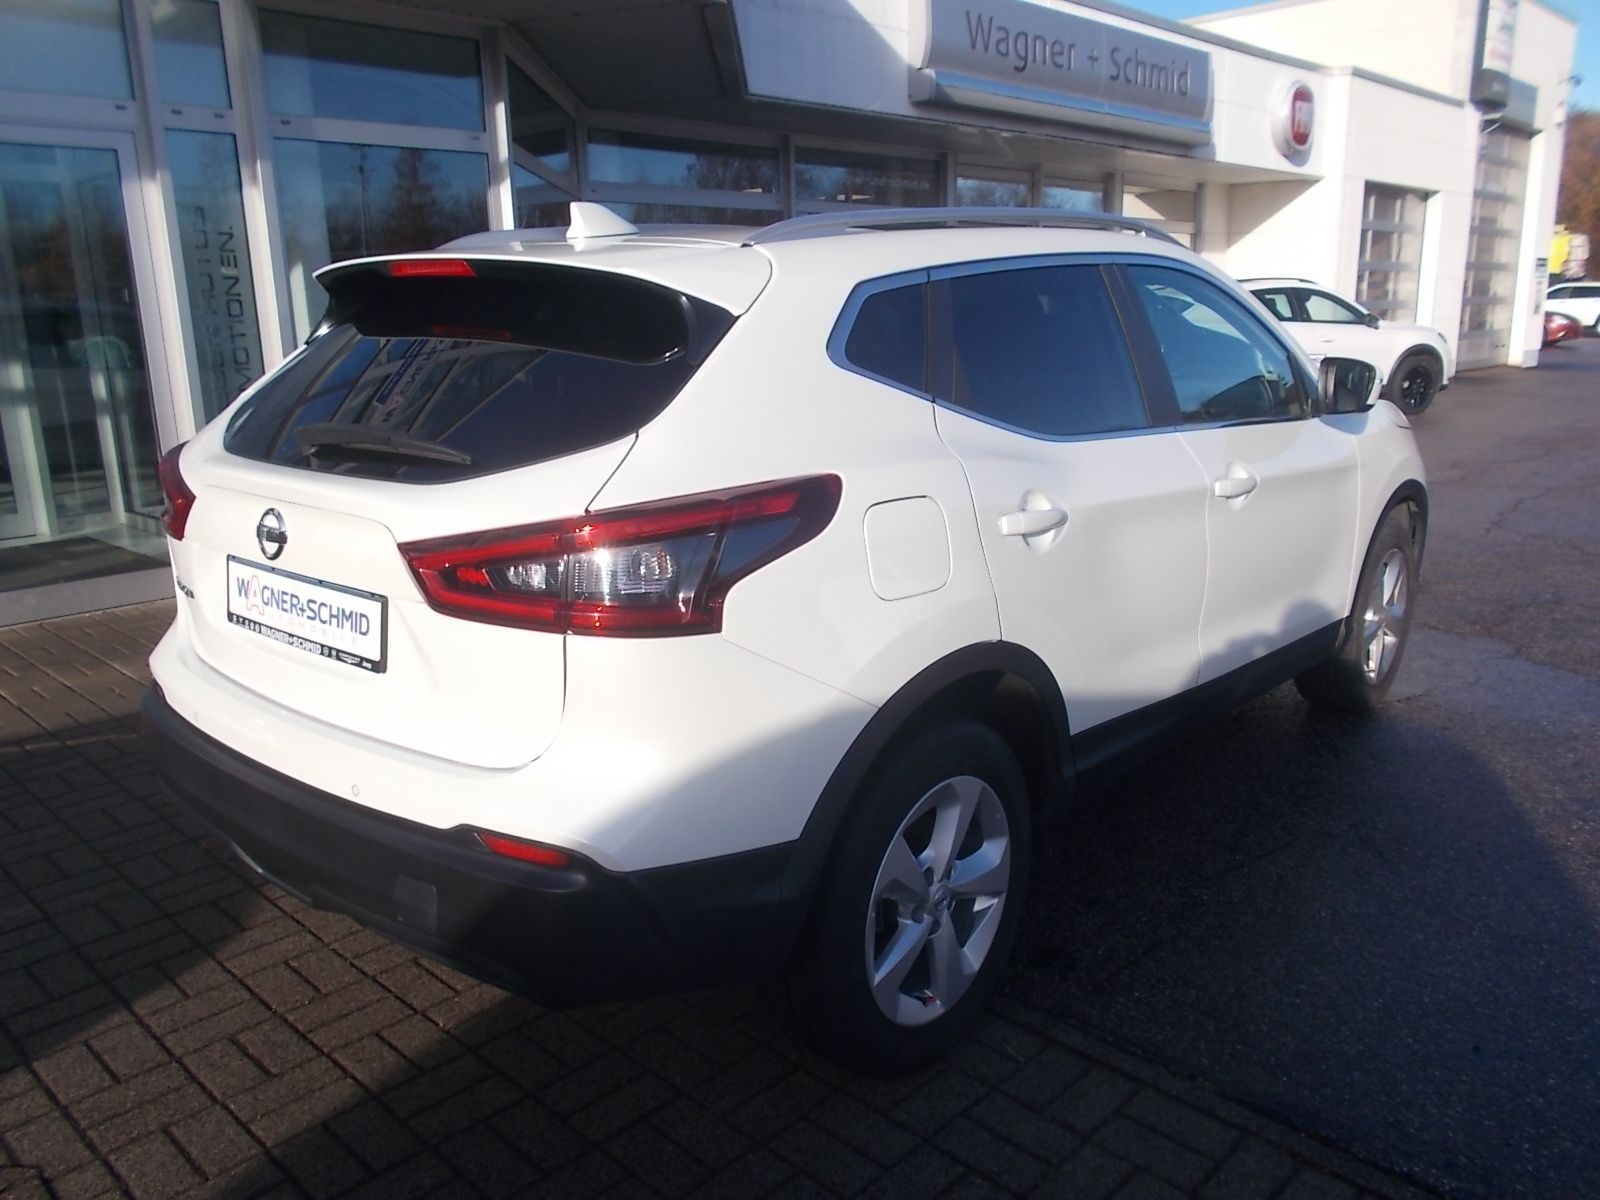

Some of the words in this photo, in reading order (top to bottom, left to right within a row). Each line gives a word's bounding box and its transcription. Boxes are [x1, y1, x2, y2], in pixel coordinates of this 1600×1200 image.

[965, 10, 1077, 73] Wagner
[1086, 48, 1100, 69] +
[1109, 46, 1192, 97] Schmid
[236, 574, 371, 637] WAGNER+SCHMID
[260, 624, 322, 656] WAGNER+SCHMID
